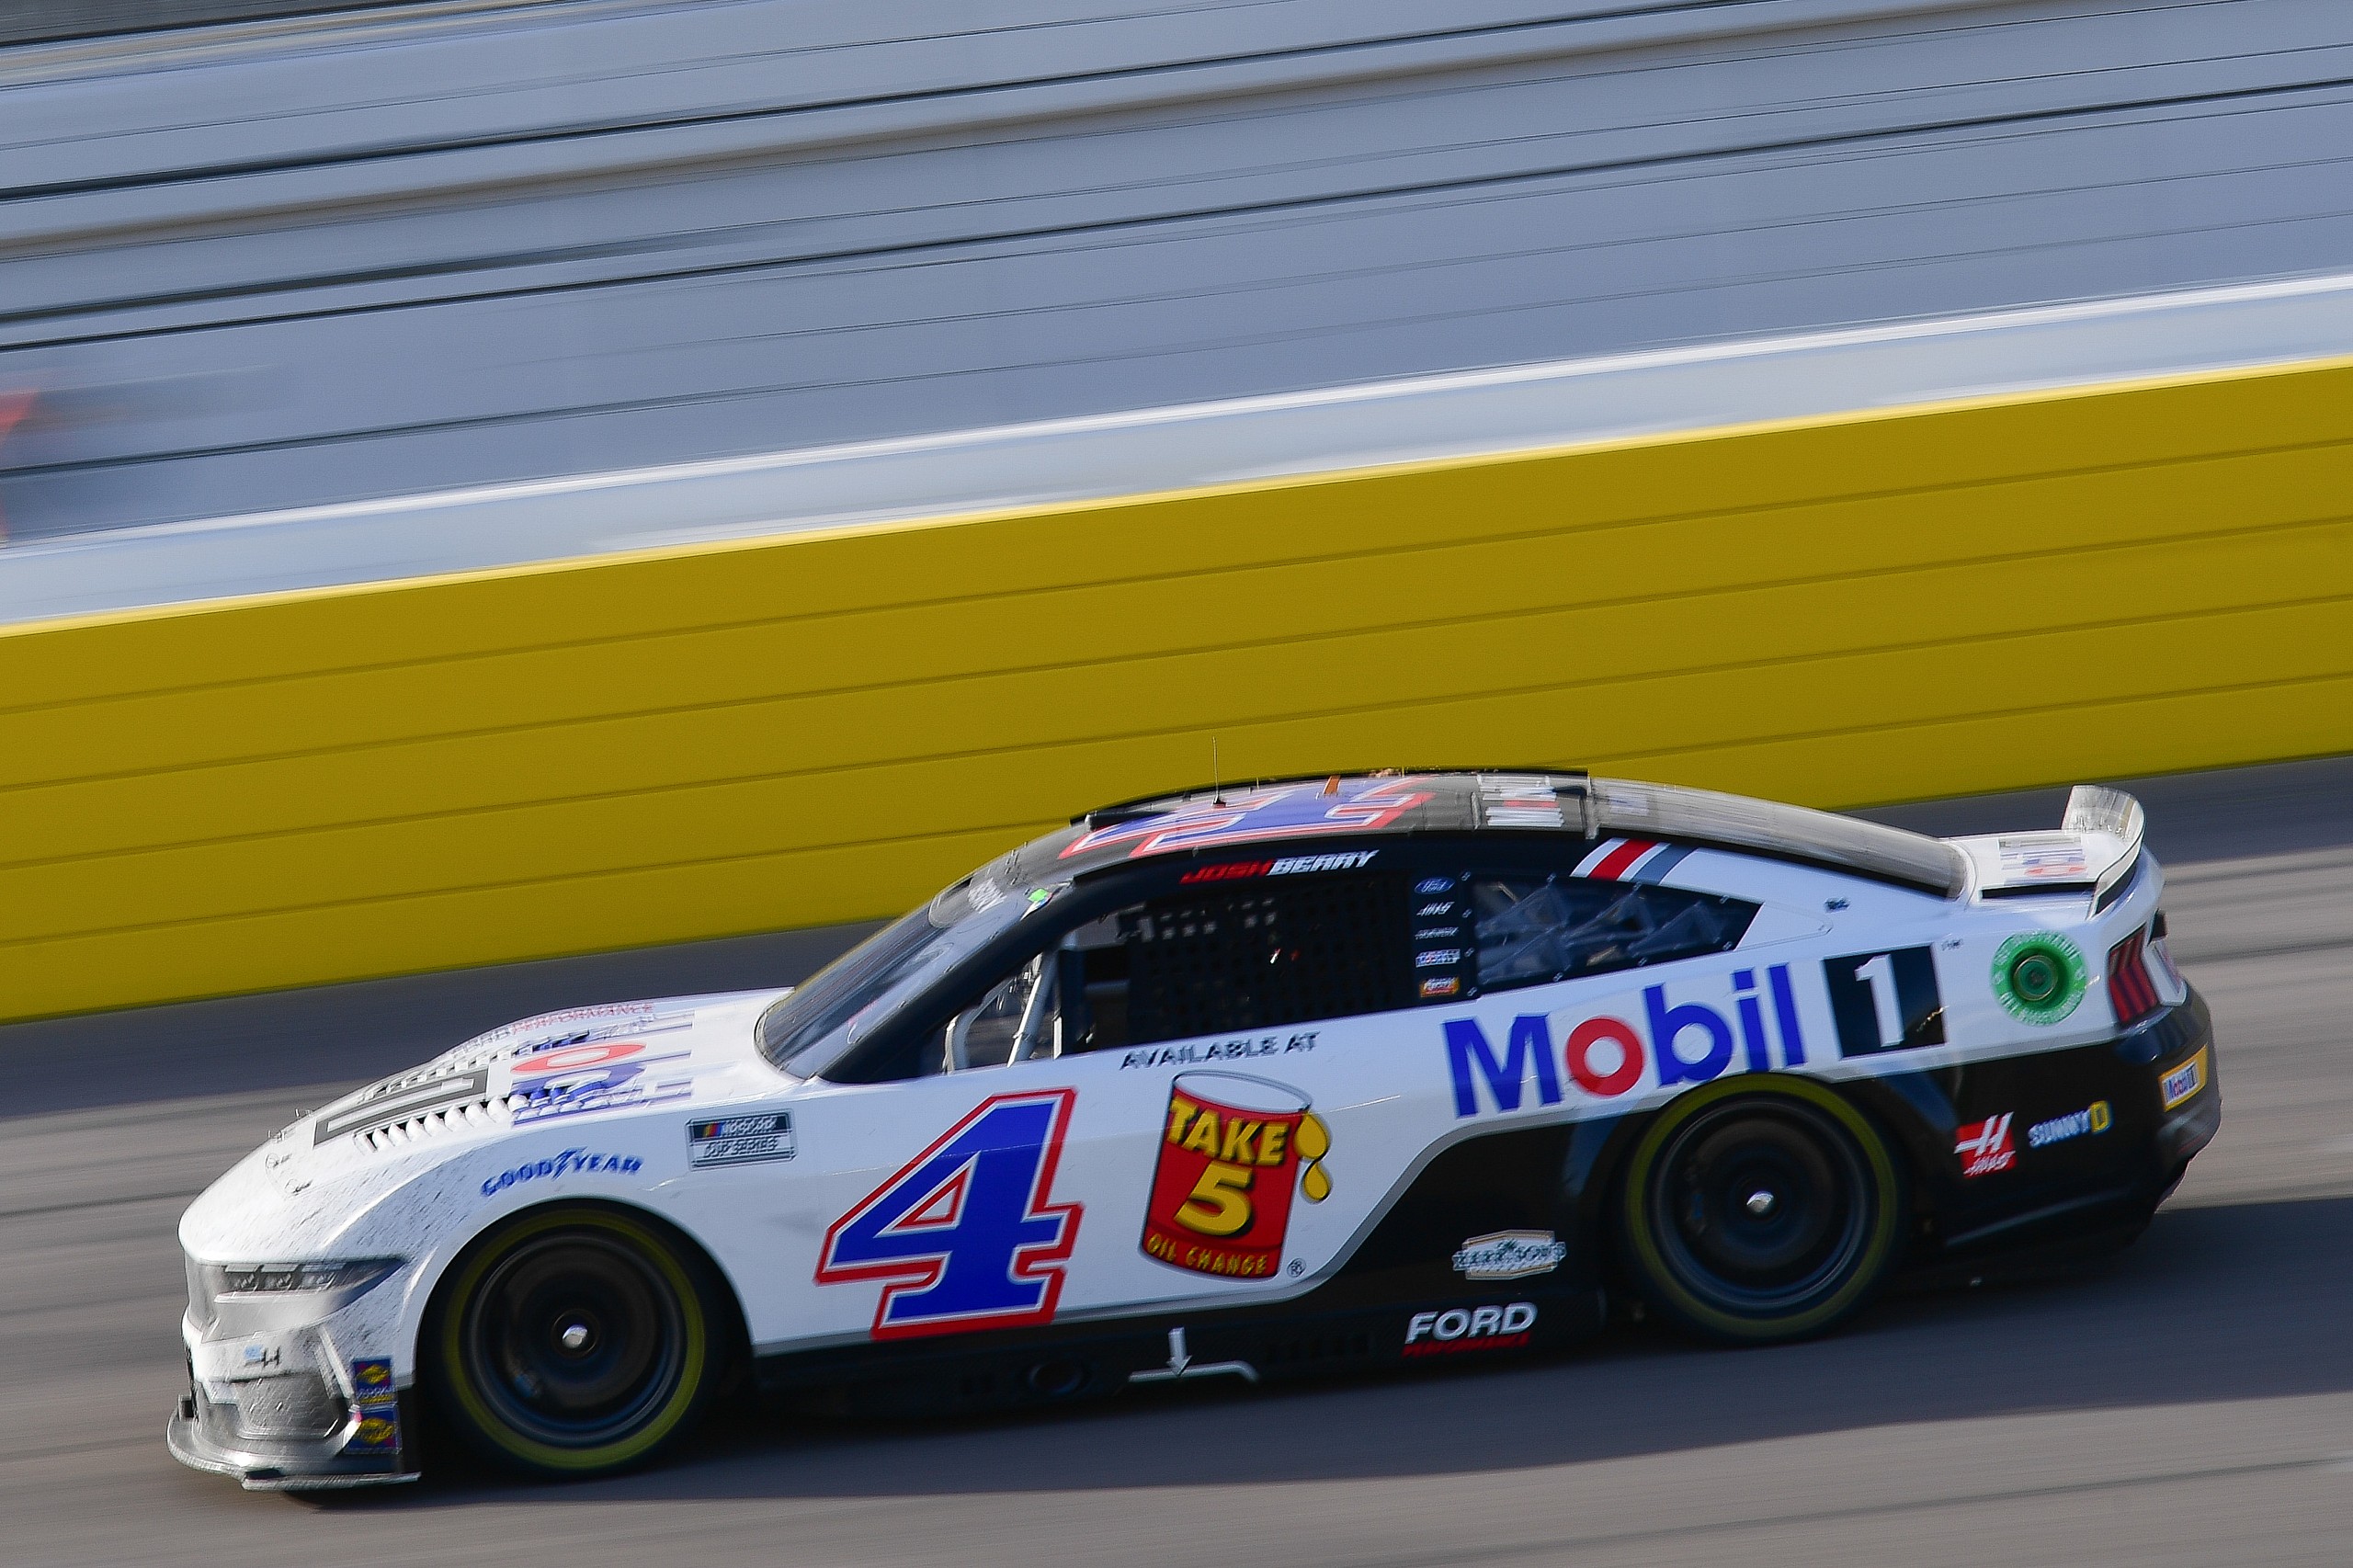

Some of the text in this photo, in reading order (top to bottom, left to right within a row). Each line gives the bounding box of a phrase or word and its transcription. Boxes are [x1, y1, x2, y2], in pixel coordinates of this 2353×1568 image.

[1119, 1030, 1321, 1071] AVAILABLE AT
[1441, 963, 1807, 1119] Mobil
[1854, 953, 1904, 1048] 1
[1167, 1096, 1290, 1166] TAKE
[480, 1146, 643, 1198] GOODYEAR
[1173, 1160, 1256, 1237] 5
[814, 1087, 1085, 1340] 4
[1148, 1233, 1269, 1276] OIL CHANGE
[1404, 1301, 1540, 1345] FORD
